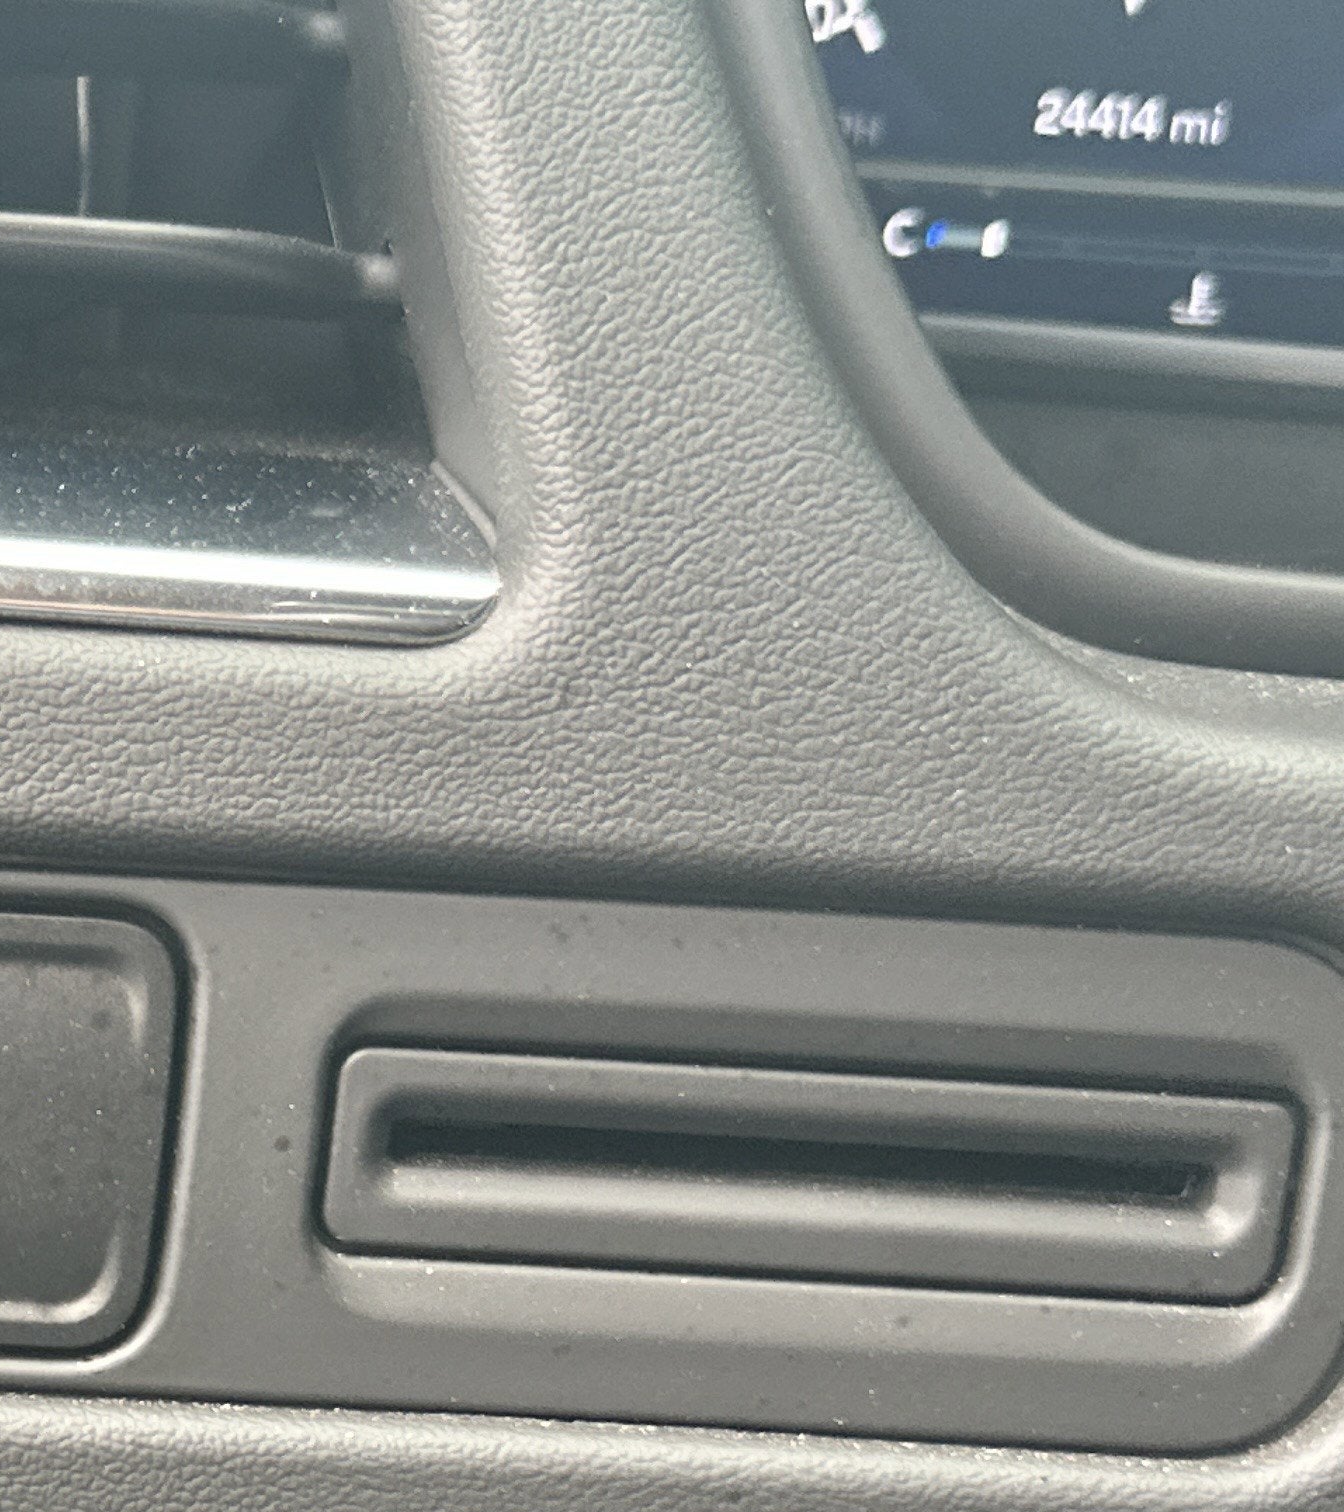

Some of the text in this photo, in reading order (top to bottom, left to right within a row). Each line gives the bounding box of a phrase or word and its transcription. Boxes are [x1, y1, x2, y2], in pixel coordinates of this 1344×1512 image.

[1033, 88, 1230, 146] 24414 mi
[882, 208, 921, 258] C
